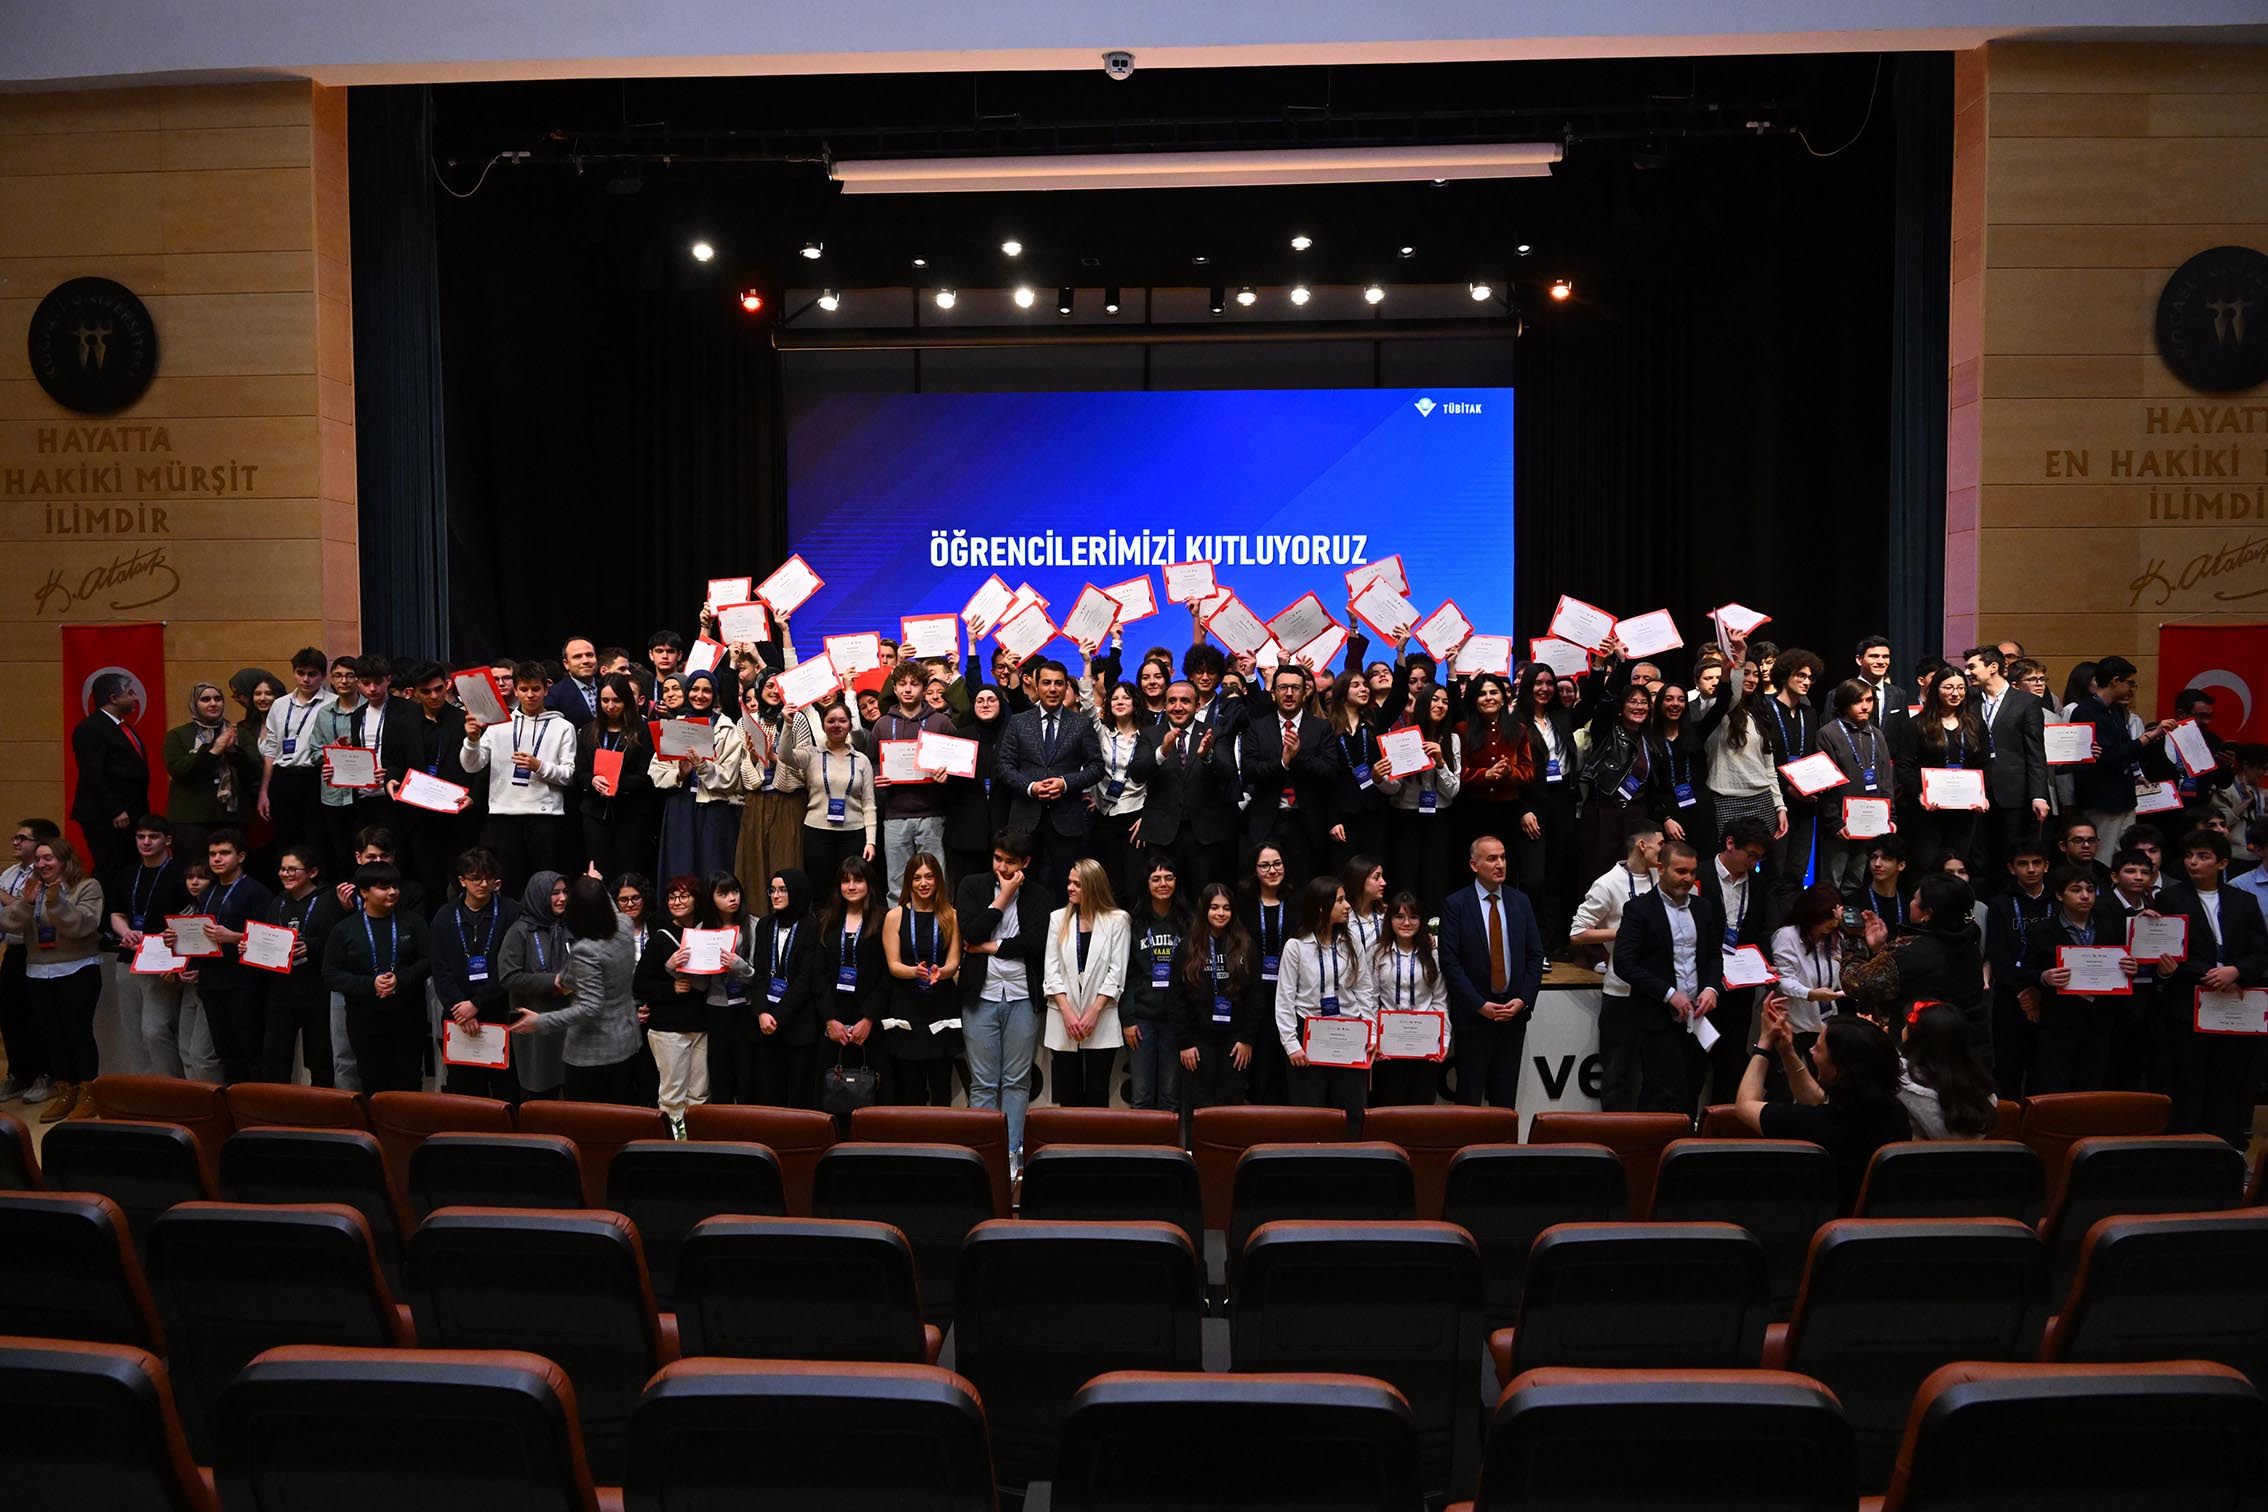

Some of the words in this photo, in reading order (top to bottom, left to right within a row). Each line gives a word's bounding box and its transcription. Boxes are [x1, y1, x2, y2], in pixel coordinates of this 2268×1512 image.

[1443, 402, 1482, 414] TÜBİTAK
[37, 426, 173, 453] HAYATTA
[2045, 450, 2089, 477] EN
[2111, 443, 2240, 477] HAKİKİ
[4, 462, 123, 494] HAKİKİ
[135, 460, 259, 495] MÜRŞİT
[45, 502, 170, 534] İLİMDİR
[930, 528, 1176, 567] ÖĞRENCİLERİMİZİ
[1186, 535, 1368, 566] KUTLUYORUZ
